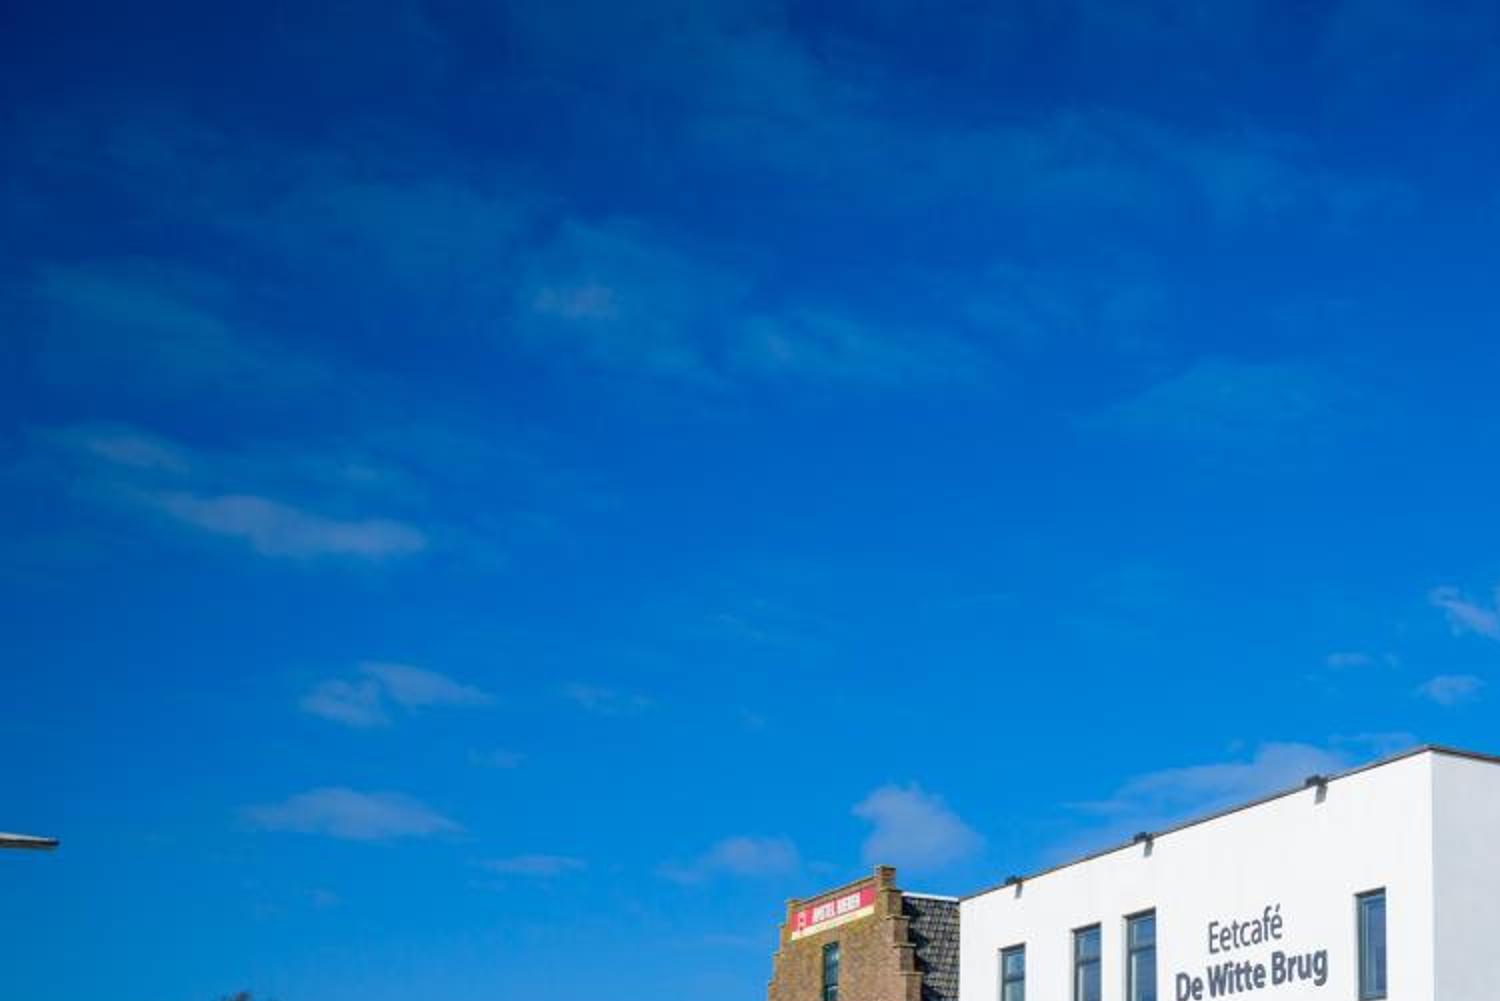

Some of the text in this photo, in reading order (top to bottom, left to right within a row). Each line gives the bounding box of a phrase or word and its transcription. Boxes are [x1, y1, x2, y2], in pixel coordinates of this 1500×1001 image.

[1208, 903, 1283, 954] Eetcafé
[1207, 960, 1266, 998] Witte
[1271, 949, 1329, 986] Brug
